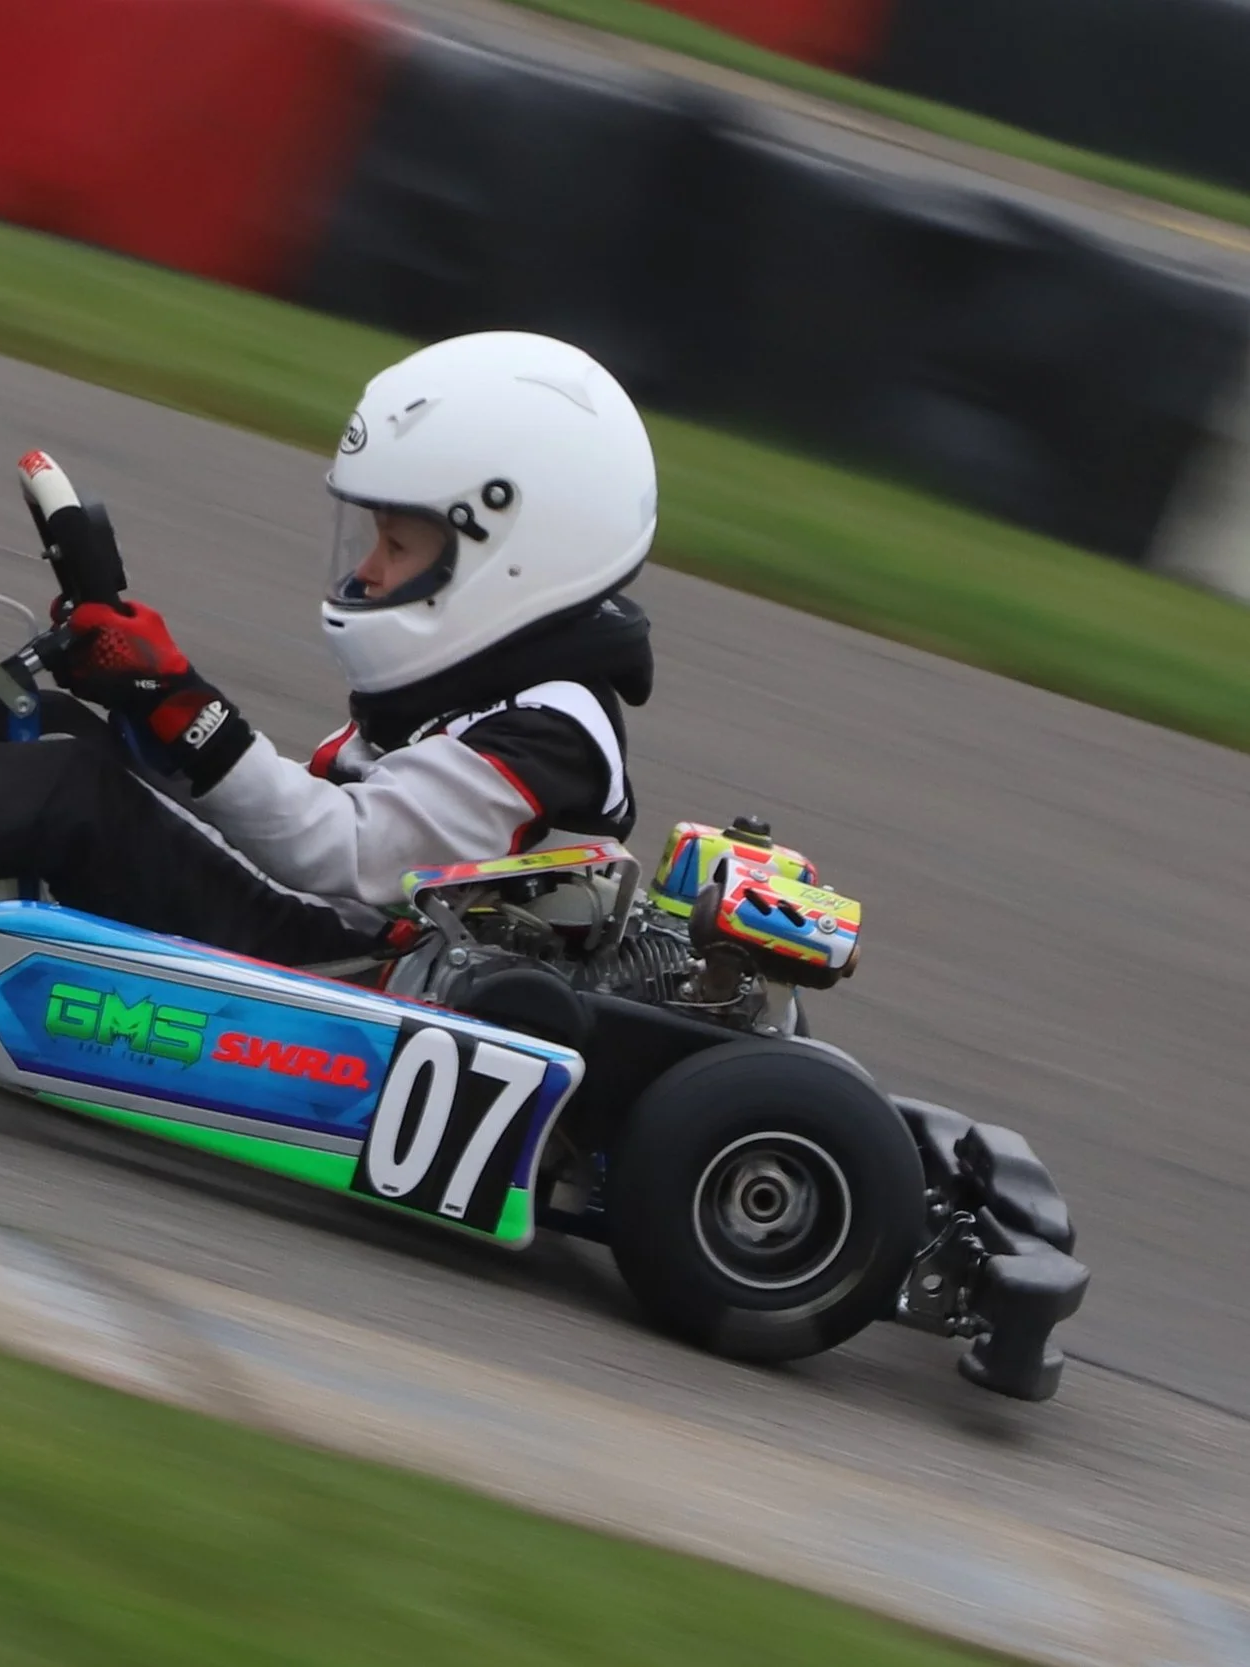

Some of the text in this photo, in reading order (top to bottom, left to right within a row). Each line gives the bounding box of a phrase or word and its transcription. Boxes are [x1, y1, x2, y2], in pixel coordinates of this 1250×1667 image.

[185, 700, 225, 745] OMP
[45, 984, 208, 1070] GMS
[368, 1027, 548, 1219] 07
